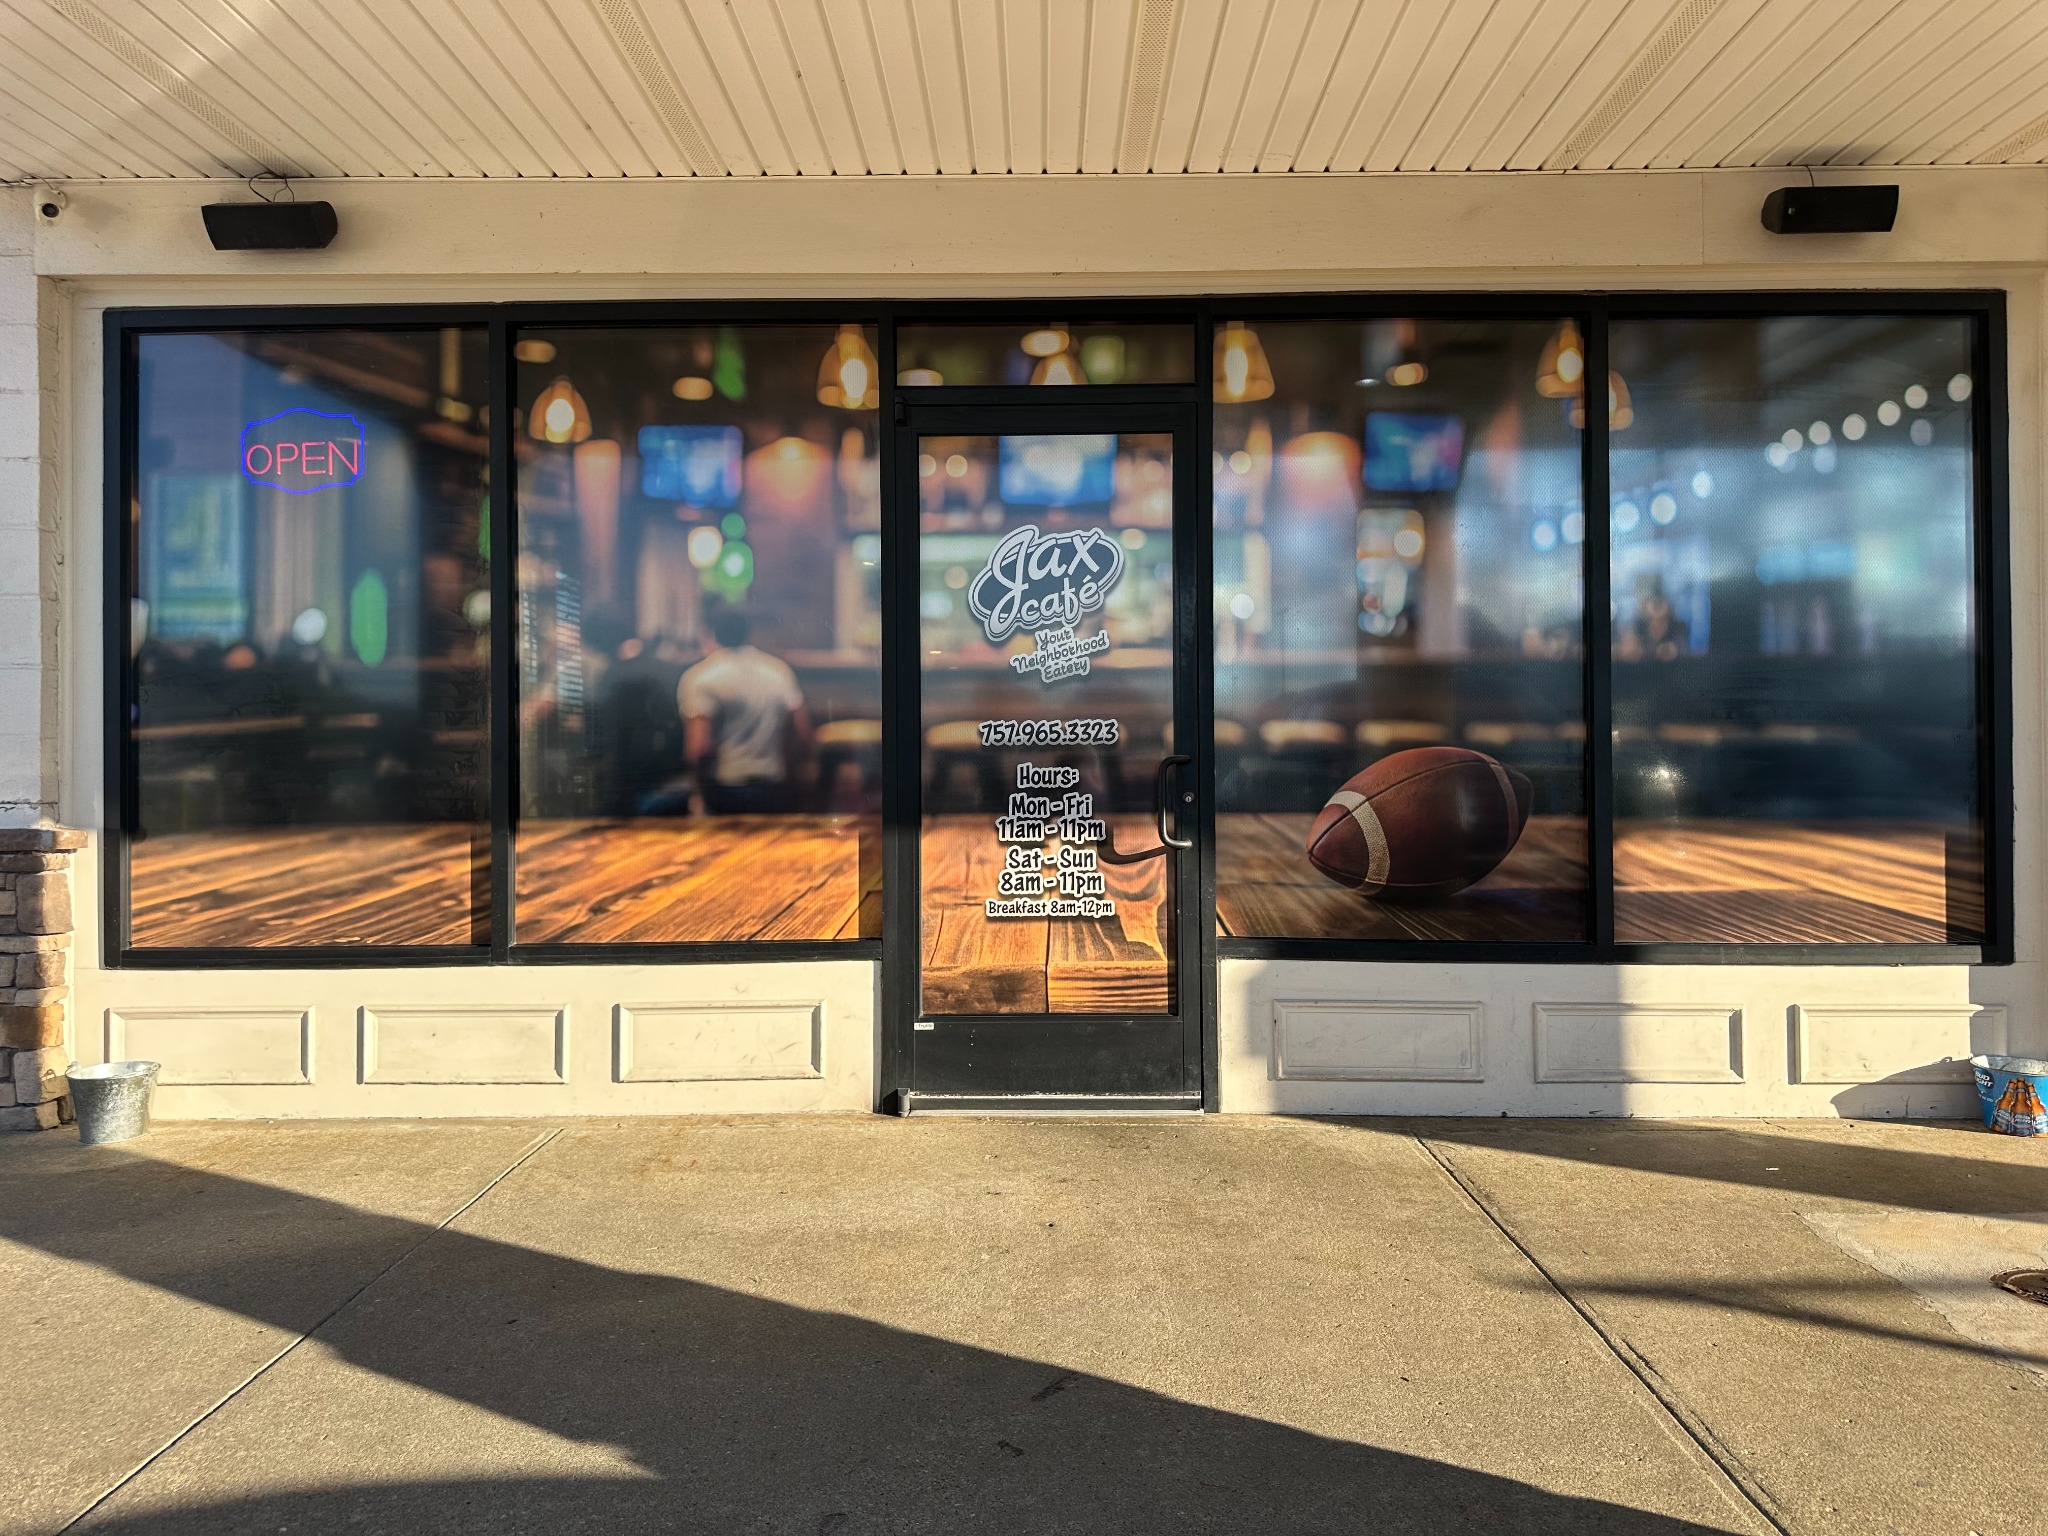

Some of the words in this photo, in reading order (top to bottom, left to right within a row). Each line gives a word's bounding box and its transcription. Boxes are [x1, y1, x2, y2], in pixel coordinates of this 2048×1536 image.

[246, 439, 358, 475] OPEN
[989, 528, 1102, 635] Jax
[1020, 575, 1099, 622] café
[1013, 632, 1107, 670] Neighborhood
[1038, 629, 1072, 651] Your
[1044, 659, 1088, 680] Eatery
[981, 721, 1116, 743] 757.965.3323
[1019, 765, 1077, 785] Hours:
[1011, 796, 1047, 816] Mon
[1066, 795, 1090, 815] Fri
[999, 819, 1042, 838] 11am
[1060, 819, 1104, 841] 11pm
[1008, 849, 1041, 868] Sat
[1060, 850, 1094, 868] Sun
[1000, 872, 1041, 892] 8am
[1059, 872, 1102, 894] 11pm
[989, 901, 1046, 914] Breakfast
[1051, 901, 1112, 916] 8am-12pm
